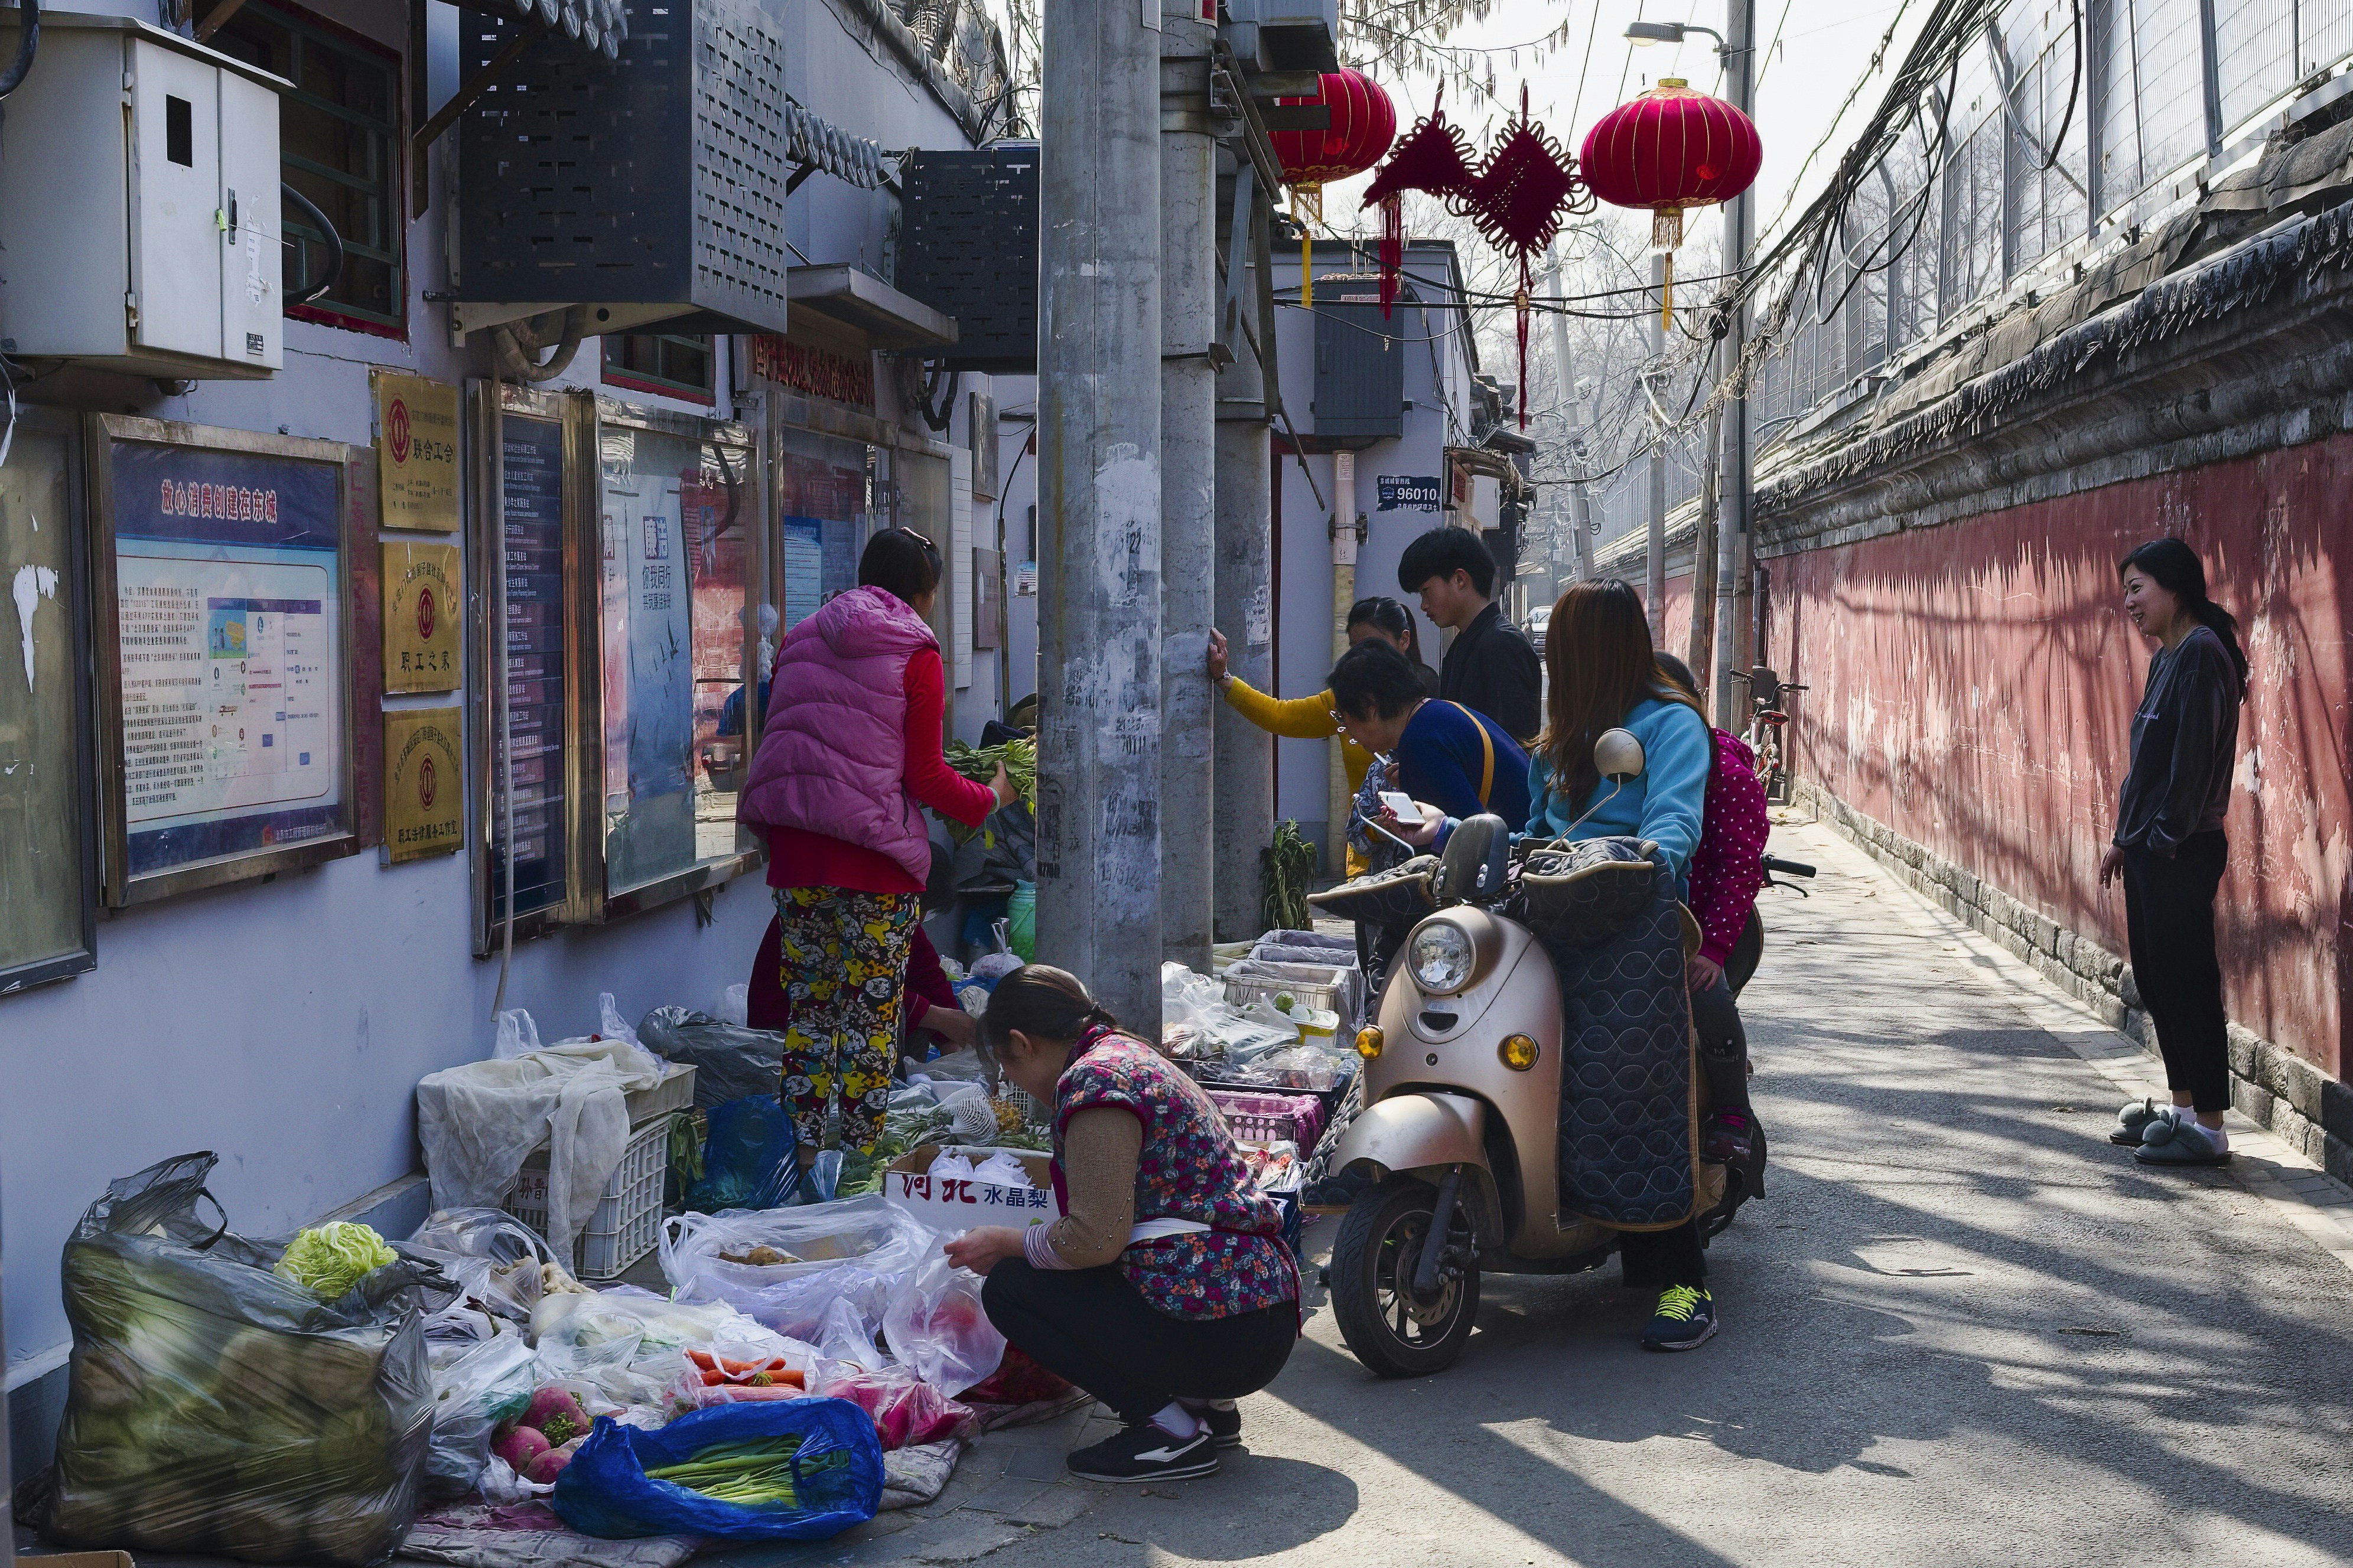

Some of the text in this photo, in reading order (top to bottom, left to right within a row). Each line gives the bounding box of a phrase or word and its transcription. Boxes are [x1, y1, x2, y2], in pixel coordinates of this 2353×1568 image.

[413, 438, 454, 464] 联合工会
[1397, 488, 1437, 500] 96010
[401, 650, 450, 672] 职工之家
[519, 1176, 548, 1201] 孙晋
[902, 1174, 1048, 1209] 河北 水晶梨
